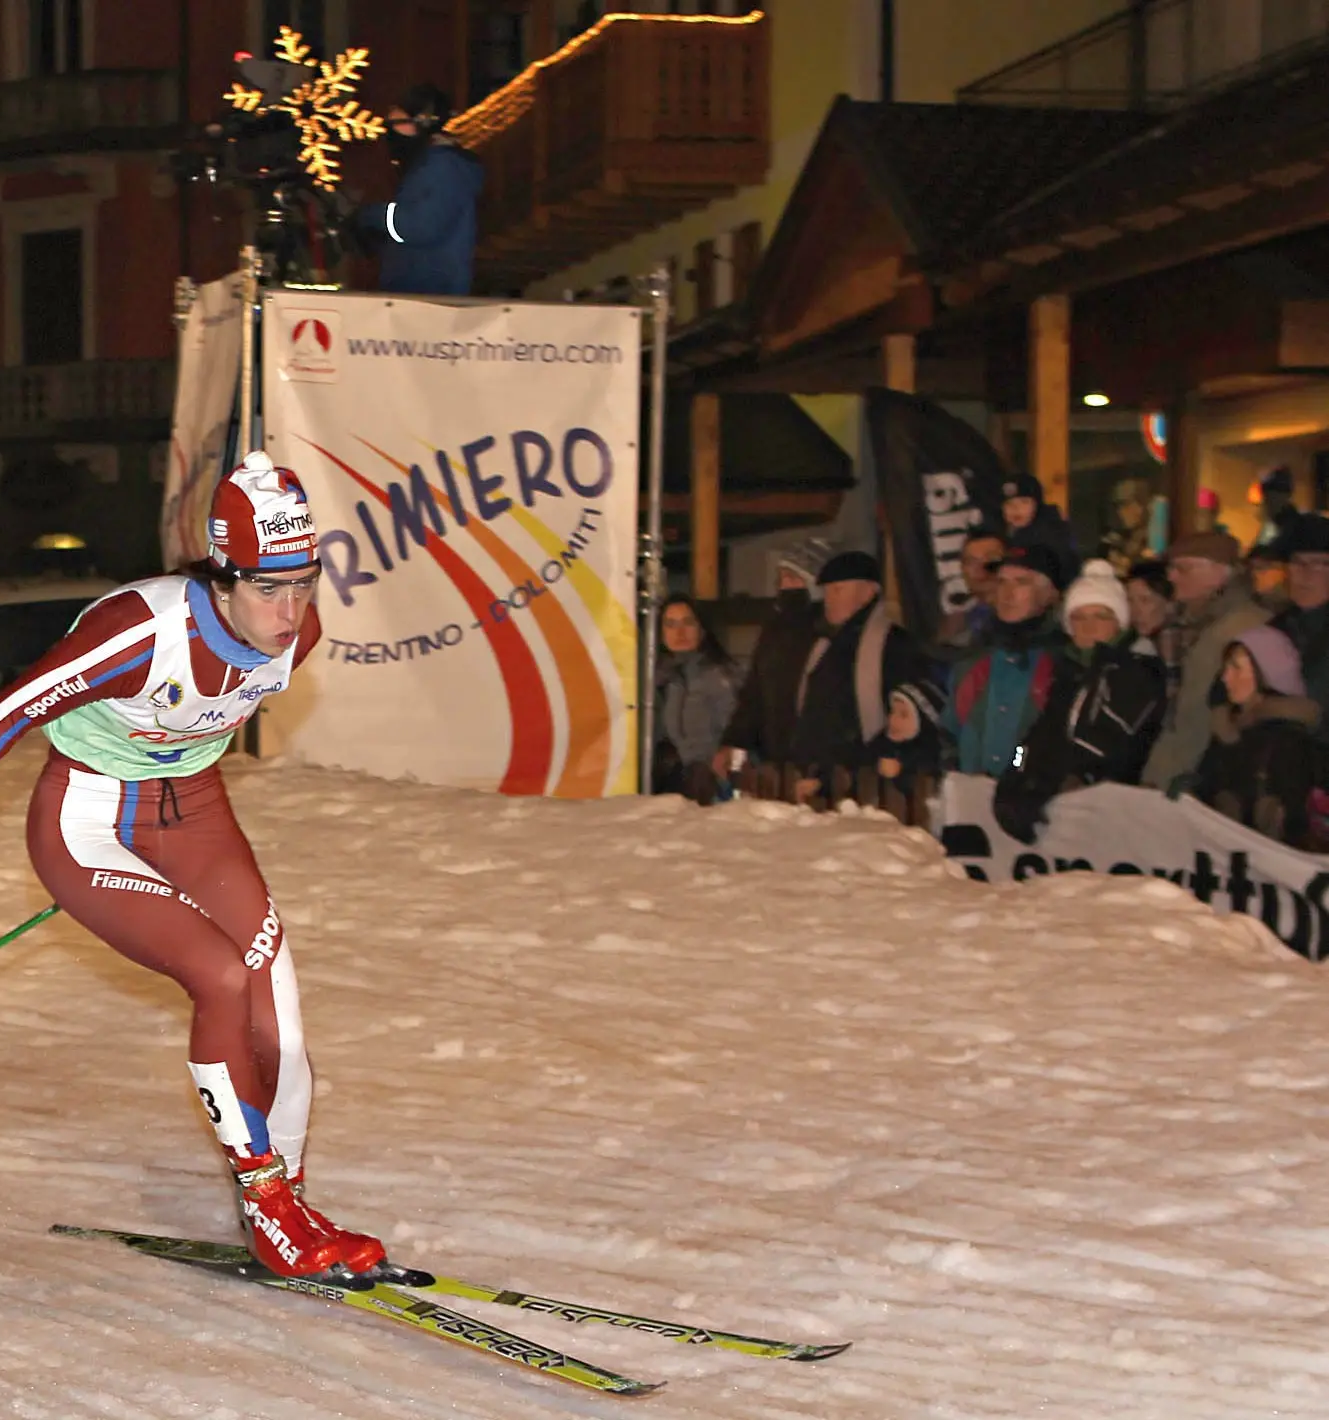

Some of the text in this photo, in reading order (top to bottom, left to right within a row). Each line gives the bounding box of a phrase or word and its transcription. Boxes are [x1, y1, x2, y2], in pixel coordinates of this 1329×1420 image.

[347, 336, 624, 366] www.usprimiero.com
[319, 426, 615, 608] RIMIERO
[258, 540, 311, 555] Fiamme
[328, 623, 464, 665] TRENTINO
[488, 507, 604, 623] DOLOMITI
[23, 674, 91, 719] sportful
[90, 871, 173, 897] Fiamme
[198, 1087, 222, 1124] 3
[286, 1277, 345, 1303] FISCHER
[419, 1311, 552, 1367] FISCHER
